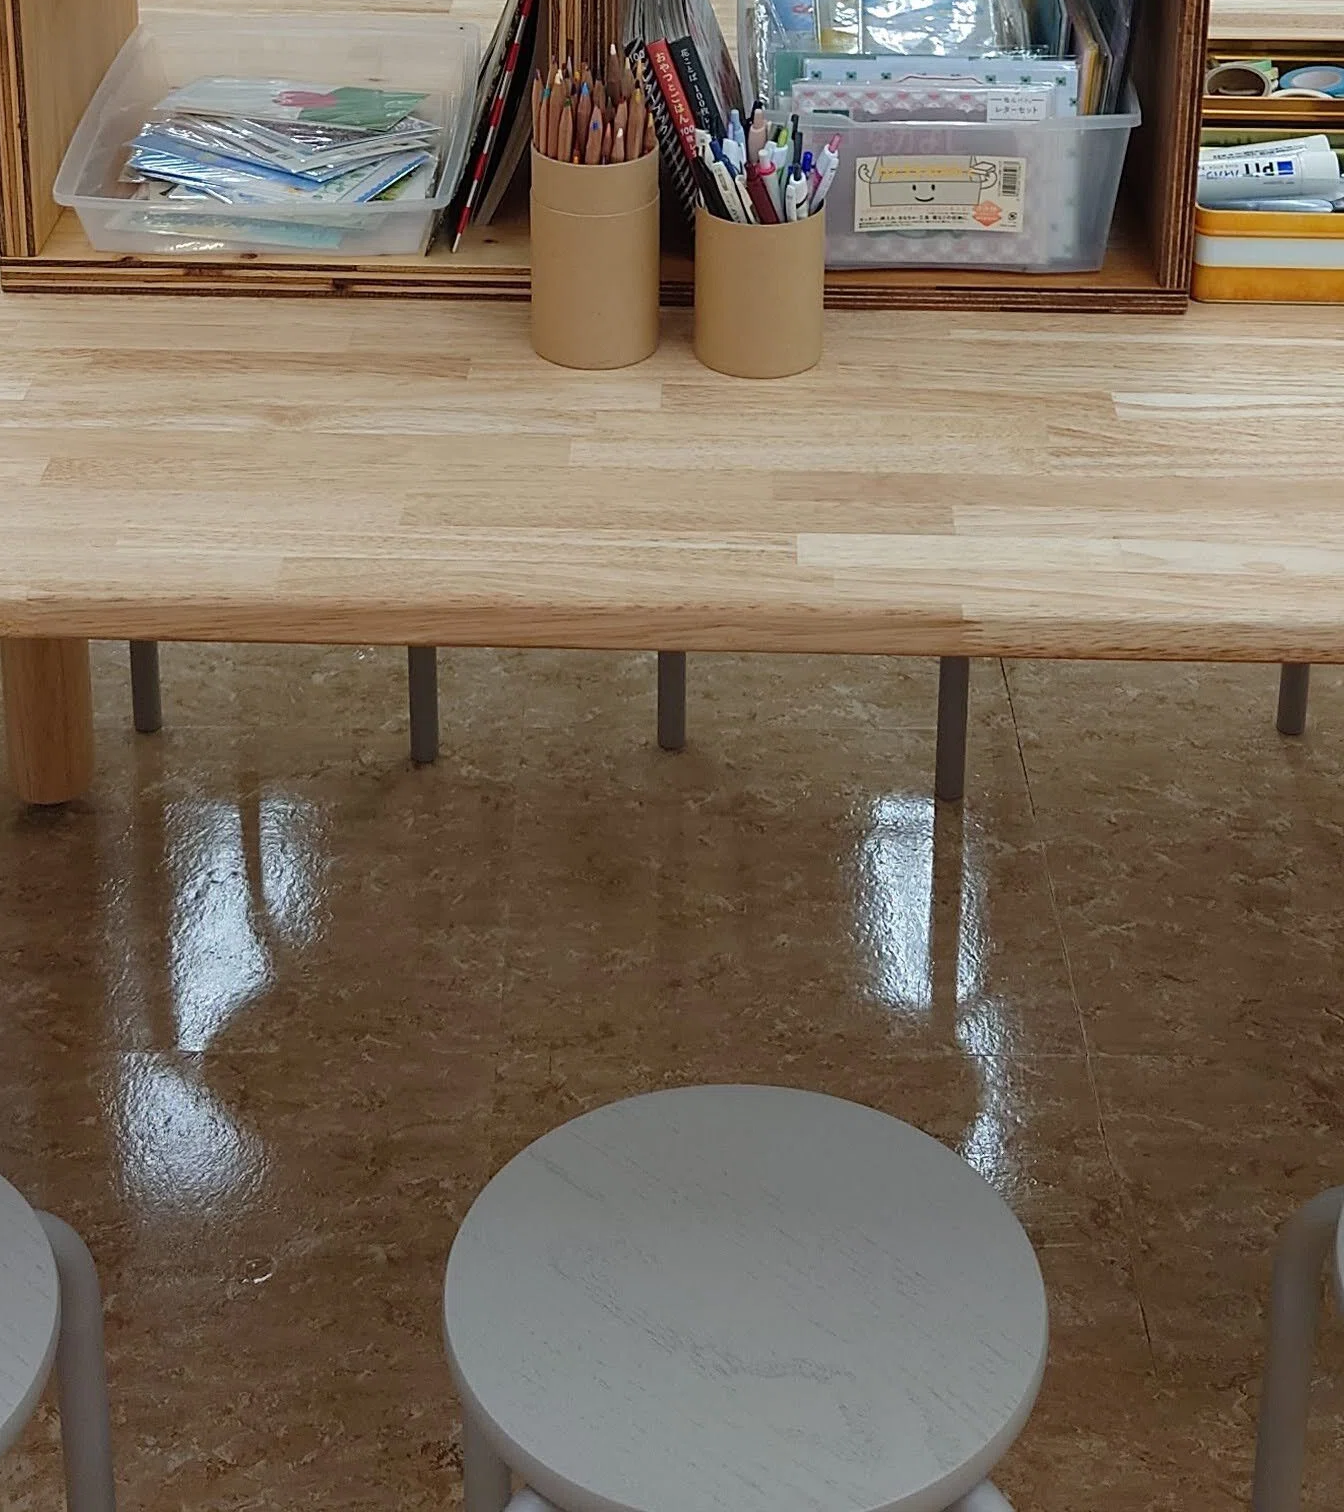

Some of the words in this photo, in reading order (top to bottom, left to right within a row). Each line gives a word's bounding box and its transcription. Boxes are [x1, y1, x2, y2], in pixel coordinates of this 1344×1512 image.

[681, 48, 698, 82] 花ことば
[656, 52, 689, 124] おやつとごはん
[995, 106, 1038, 115] レターセット
